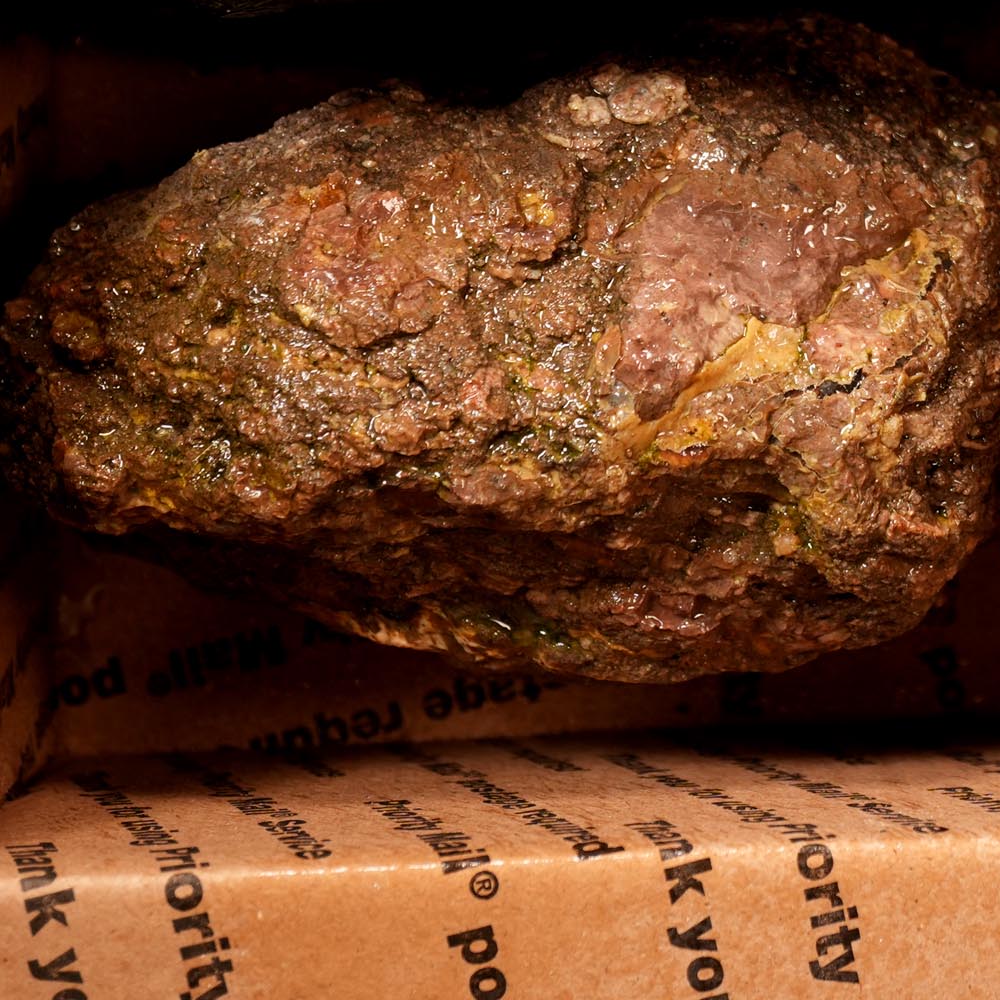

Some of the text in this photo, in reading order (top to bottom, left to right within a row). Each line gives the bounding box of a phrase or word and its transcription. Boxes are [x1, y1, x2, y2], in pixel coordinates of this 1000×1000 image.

[121, 819, 180, 846] using
[257, 819, 333, 860] Service
[364, 799, 446, 832] Priority
[516, 809, 625, 861] required
[5, 842, 76, 937] Thank
[624, 819, 730, 1000] Thank yo
[769, 824, 861, 984] Priority
